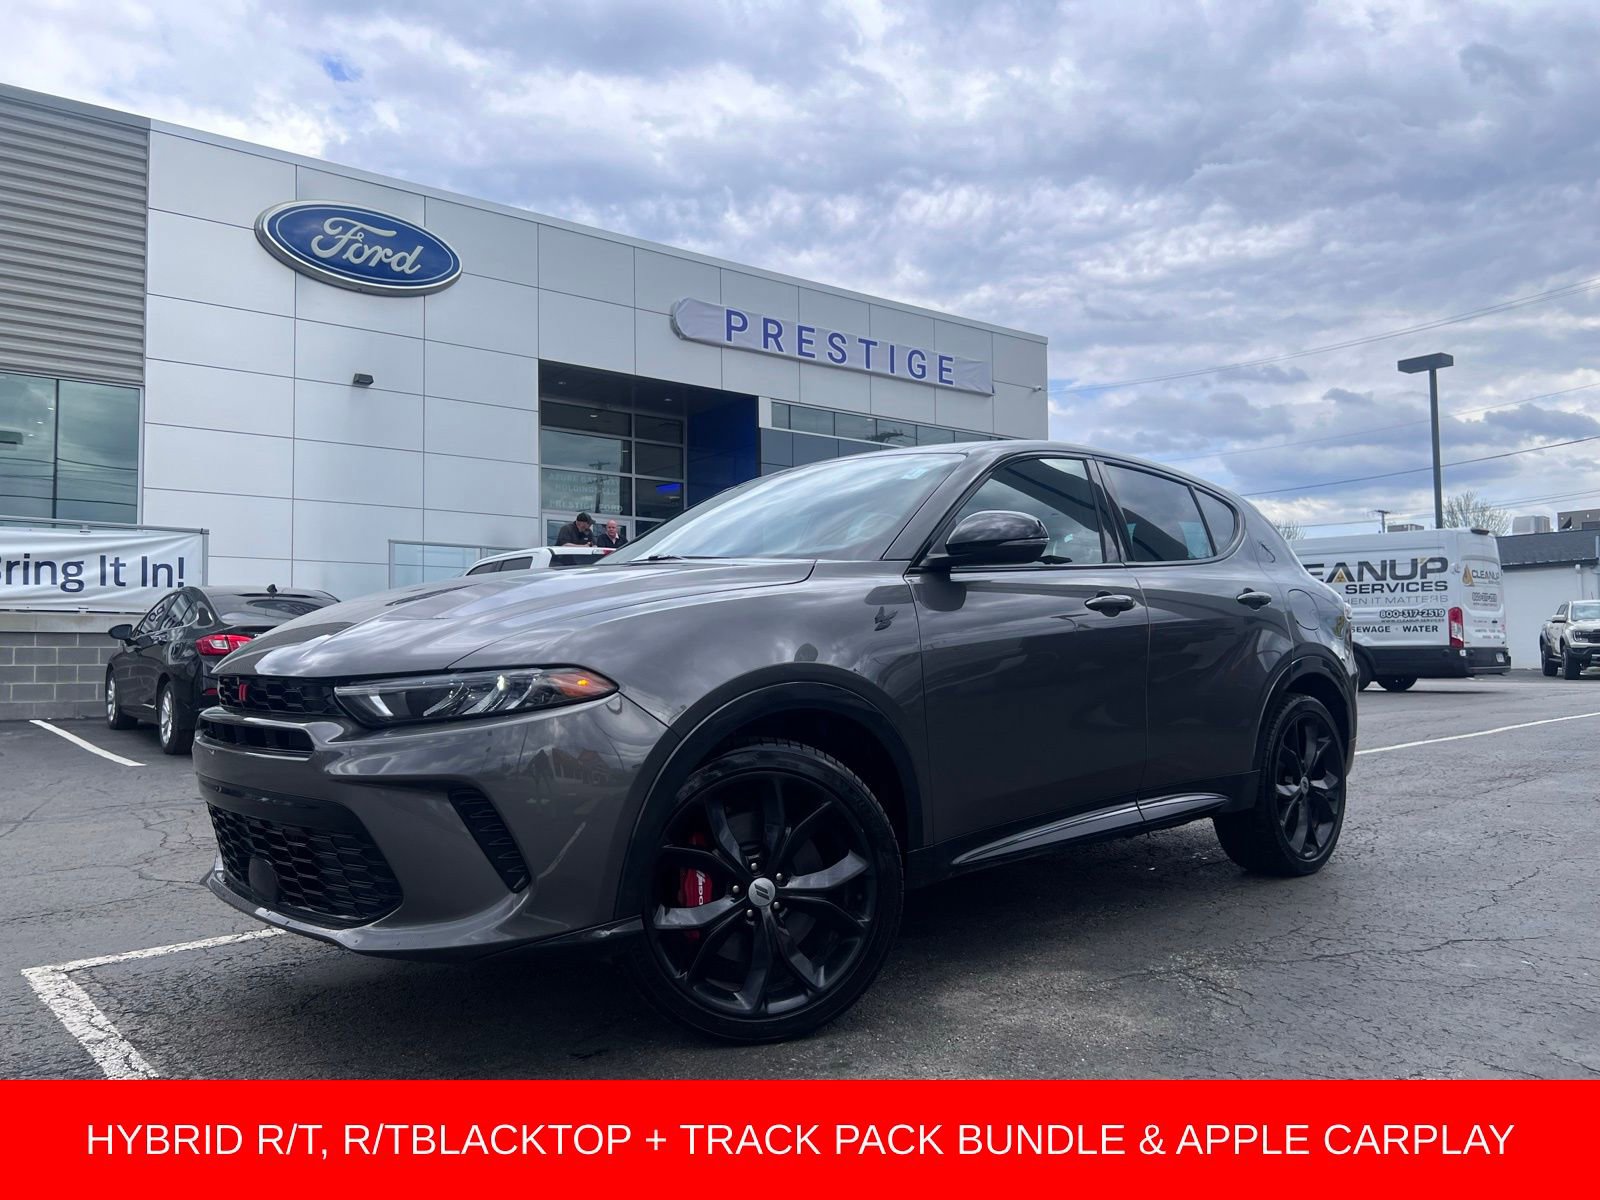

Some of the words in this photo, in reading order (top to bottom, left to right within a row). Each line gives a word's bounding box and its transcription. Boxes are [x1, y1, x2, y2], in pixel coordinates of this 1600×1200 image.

[311, 217, 424, 275] Ford
[724, 308, 955, 386] PRESTIGE
[0, 553, 84, 592] ring
[100, 555, 126, 587] It
[141, 556, 185, 588] In!
[1345, 580, 1448, 594] SERVICES
[1371, 596, 1381, 605] IT
[1379, 608, 1446, 619] 800-317-2519
[1402, 624, 1439, 633] WATER
